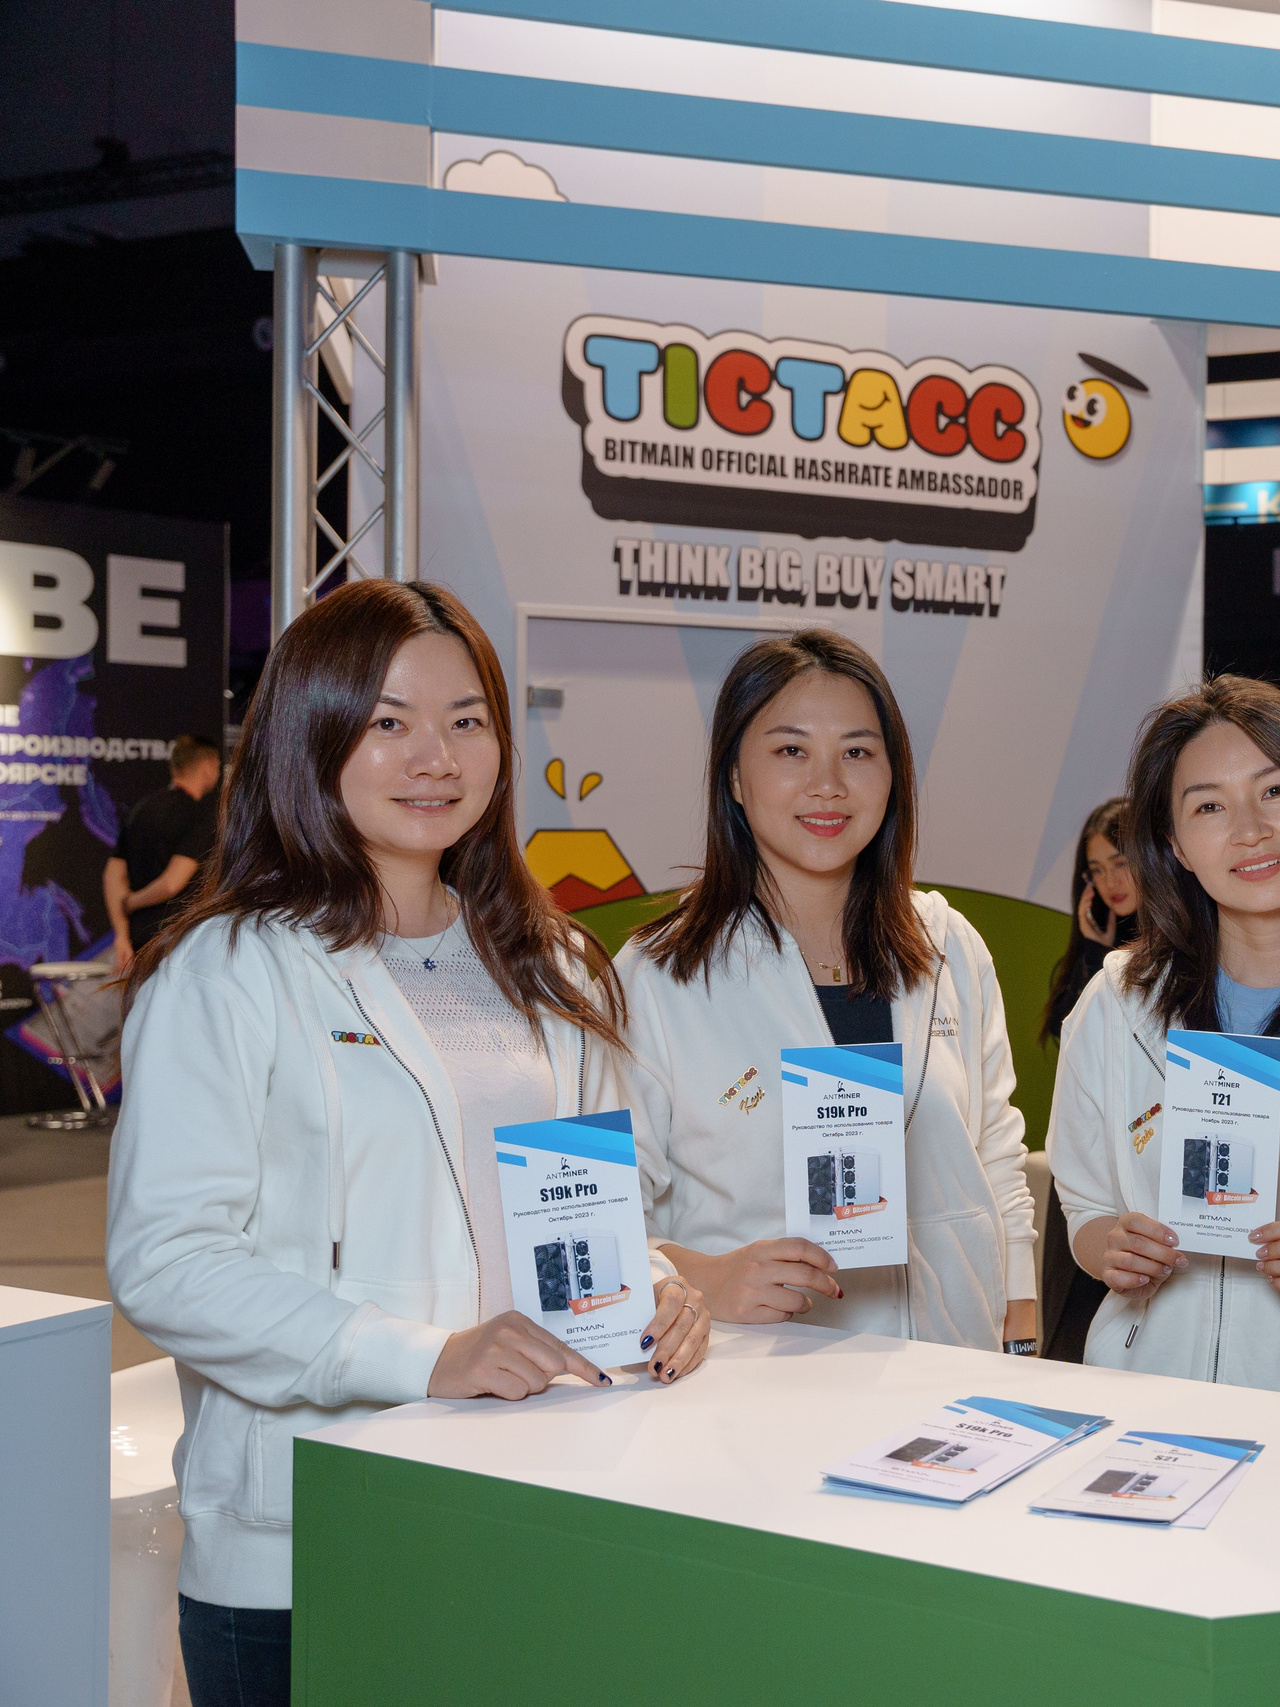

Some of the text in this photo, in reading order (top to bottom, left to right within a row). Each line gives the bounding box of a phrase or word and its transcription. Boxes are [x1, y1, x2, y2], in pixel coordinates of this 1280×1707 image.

[583, 335, 1026, 463] TICTACC
[604, 437, 1024, 501] BITMAIN OFFICIAL HASHRATE AMBASSADOR
[614, 538, 1007, 611] THINK BIG, BUY SMART
[1203, 1080, 1240, 1089] ANTMINER
[823, 1093, 861, 1101] ANTMINER
[1212, 1093, 1231, 1106] T21
[817, 1105, 868, 1119] S19k Pro
[545, 1169, 589, 1181] ANTMINER
[540, 1183, 598, 1203] S19k Pro
[513, 1208, 551, 1218] Руководство
[560, 1199, 607, 1211] использованию
[608, 1196, 629, 1205] товара
[548, 1214, 574, 1223] Октябрь
[1199, 1214, 1232, 1222] BITMAIN
[566, 1323, 605, 1335] BITMAIN
[588, 1331, 629, 1342] TECHNOLOGIES
[955, 1423, 988, 1434] S19k
[989, 1429, 1013, 1438] Pro
[1154, 1455, 1179, 1463] S21
